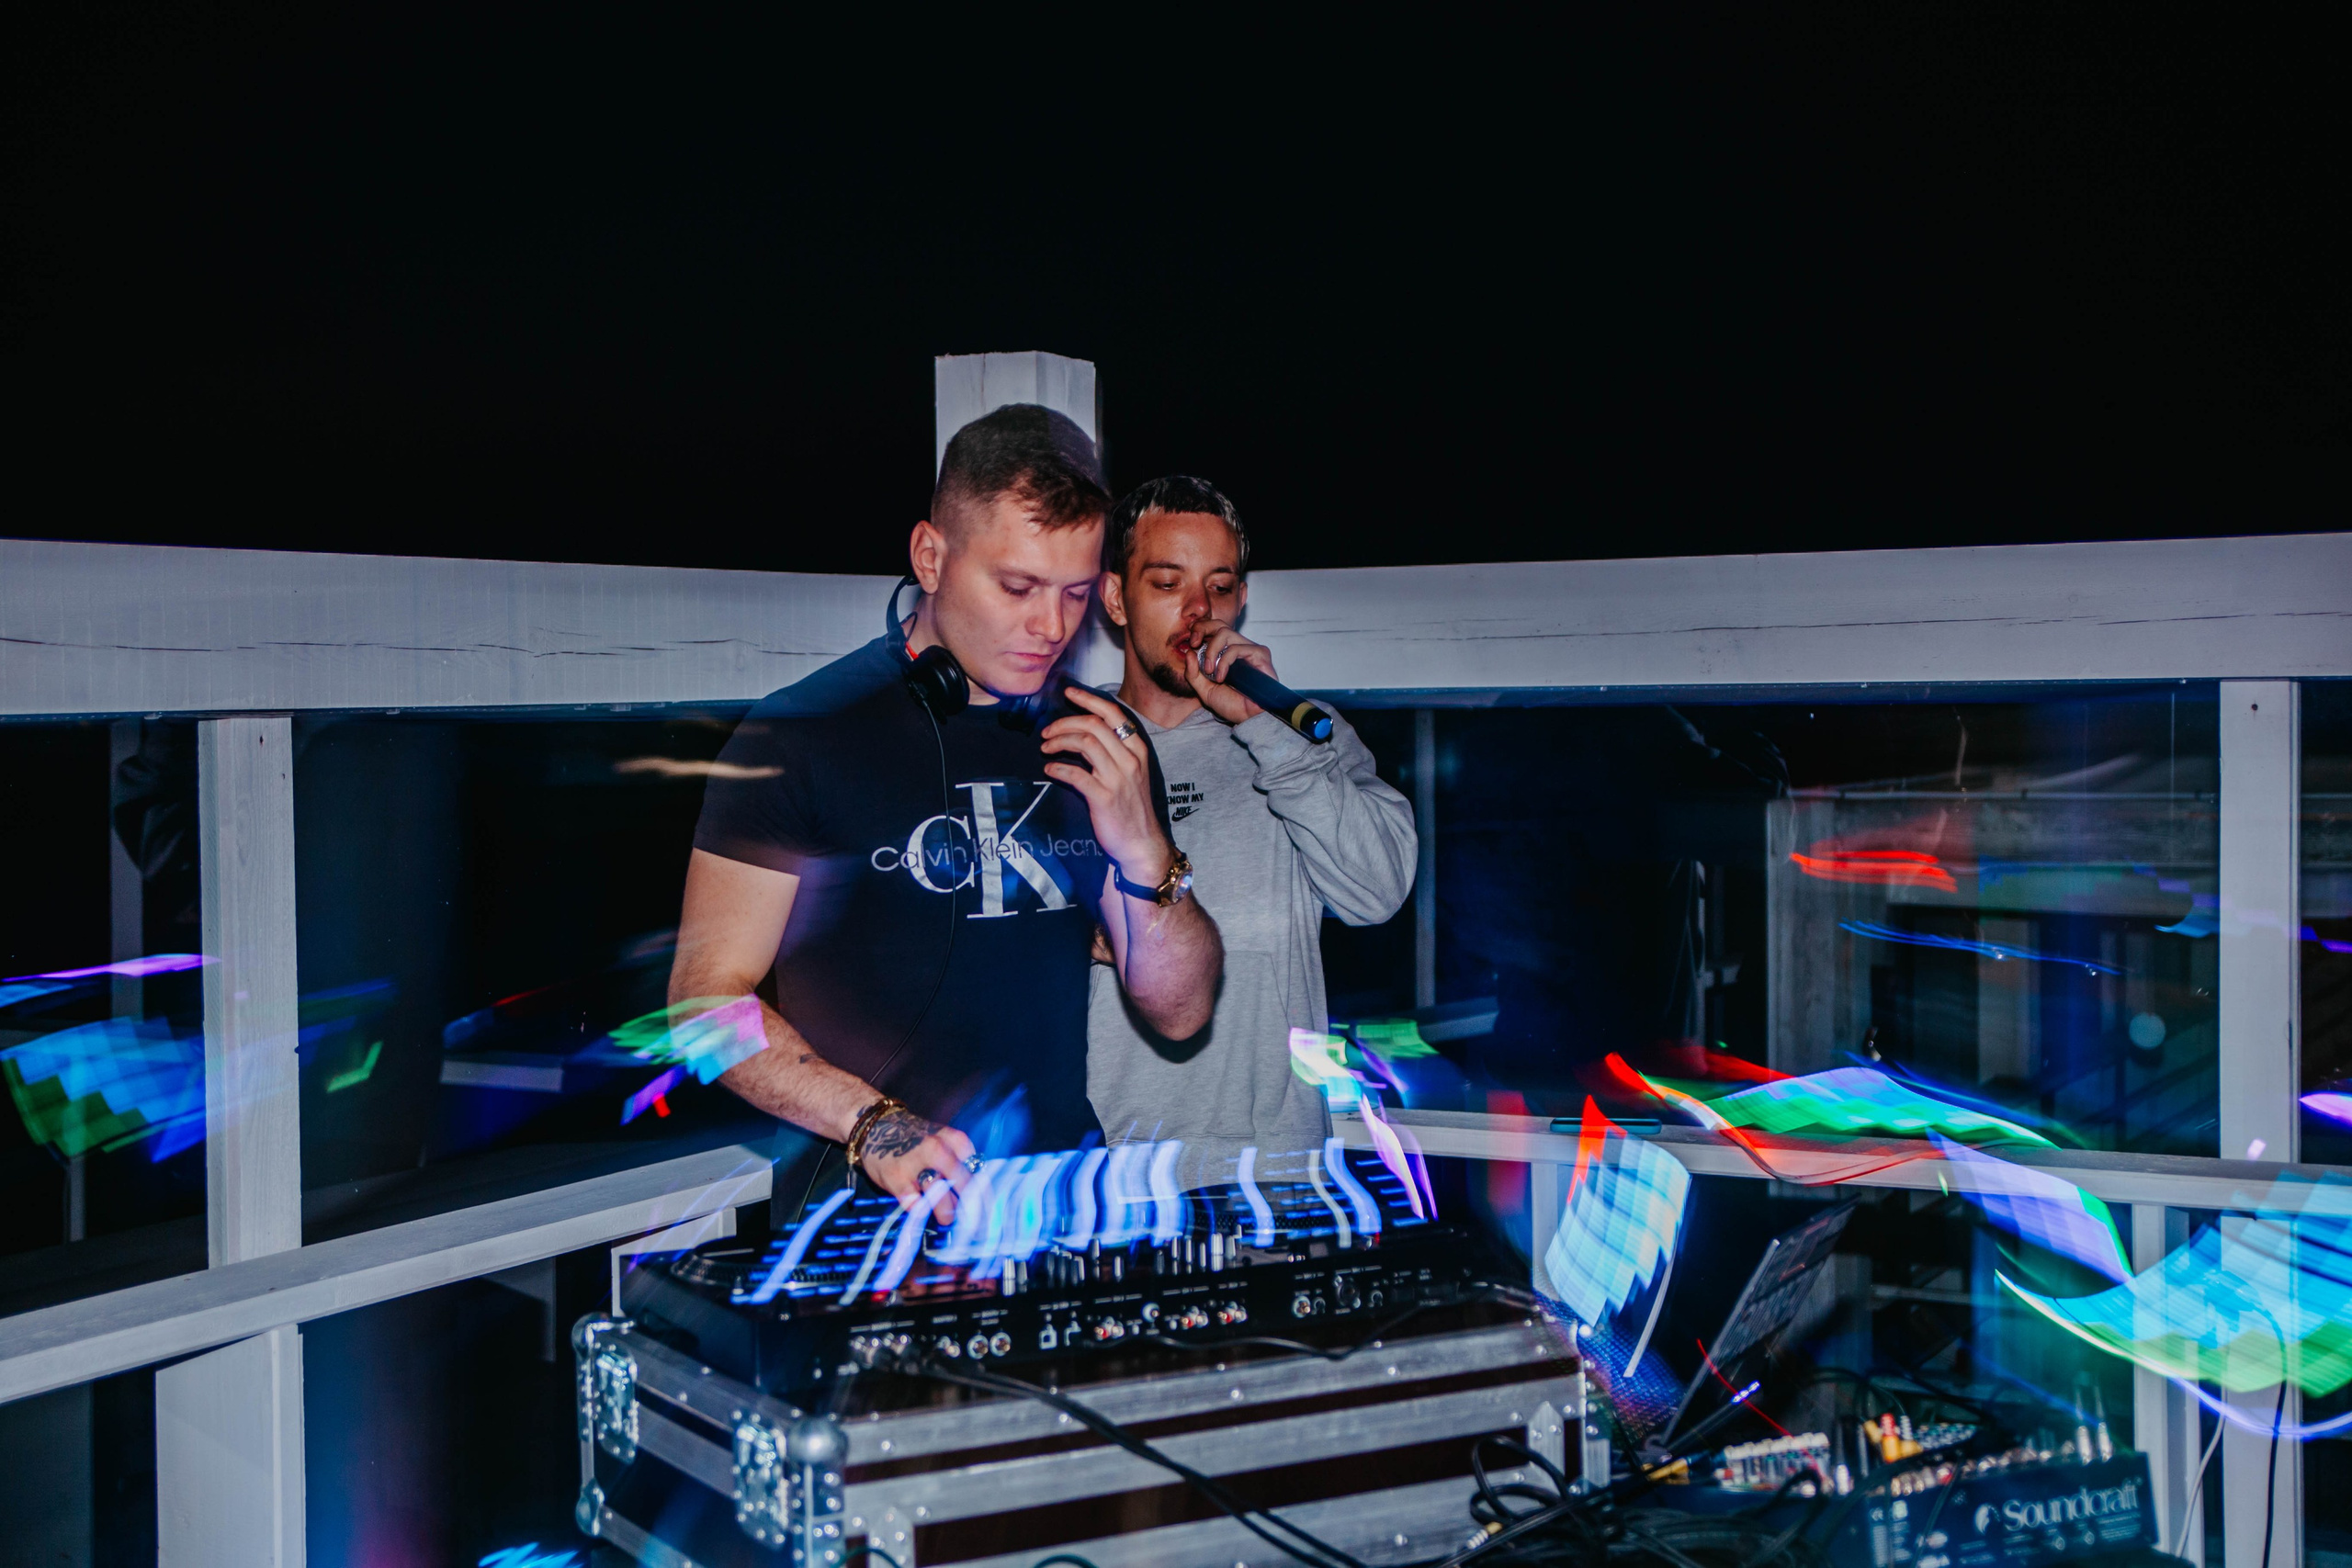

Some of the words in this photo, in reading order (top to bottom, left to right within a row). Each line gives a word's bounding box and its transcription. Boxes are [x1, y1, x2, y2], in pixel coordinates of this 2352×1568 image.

[1170, 783, 1191, 792] NOW
[1192, 782, 1195, 791] I
[1191, 793, 1204, 802] MY
[1176, 806, 1193, 817] NIKE
[871, 841, 967, 872] Calvin
[972, 834, 1035, 863] Klein
[905, 781, 1077, 919] CK
[2003, 1479, 2139, 1531] Soundcraft
